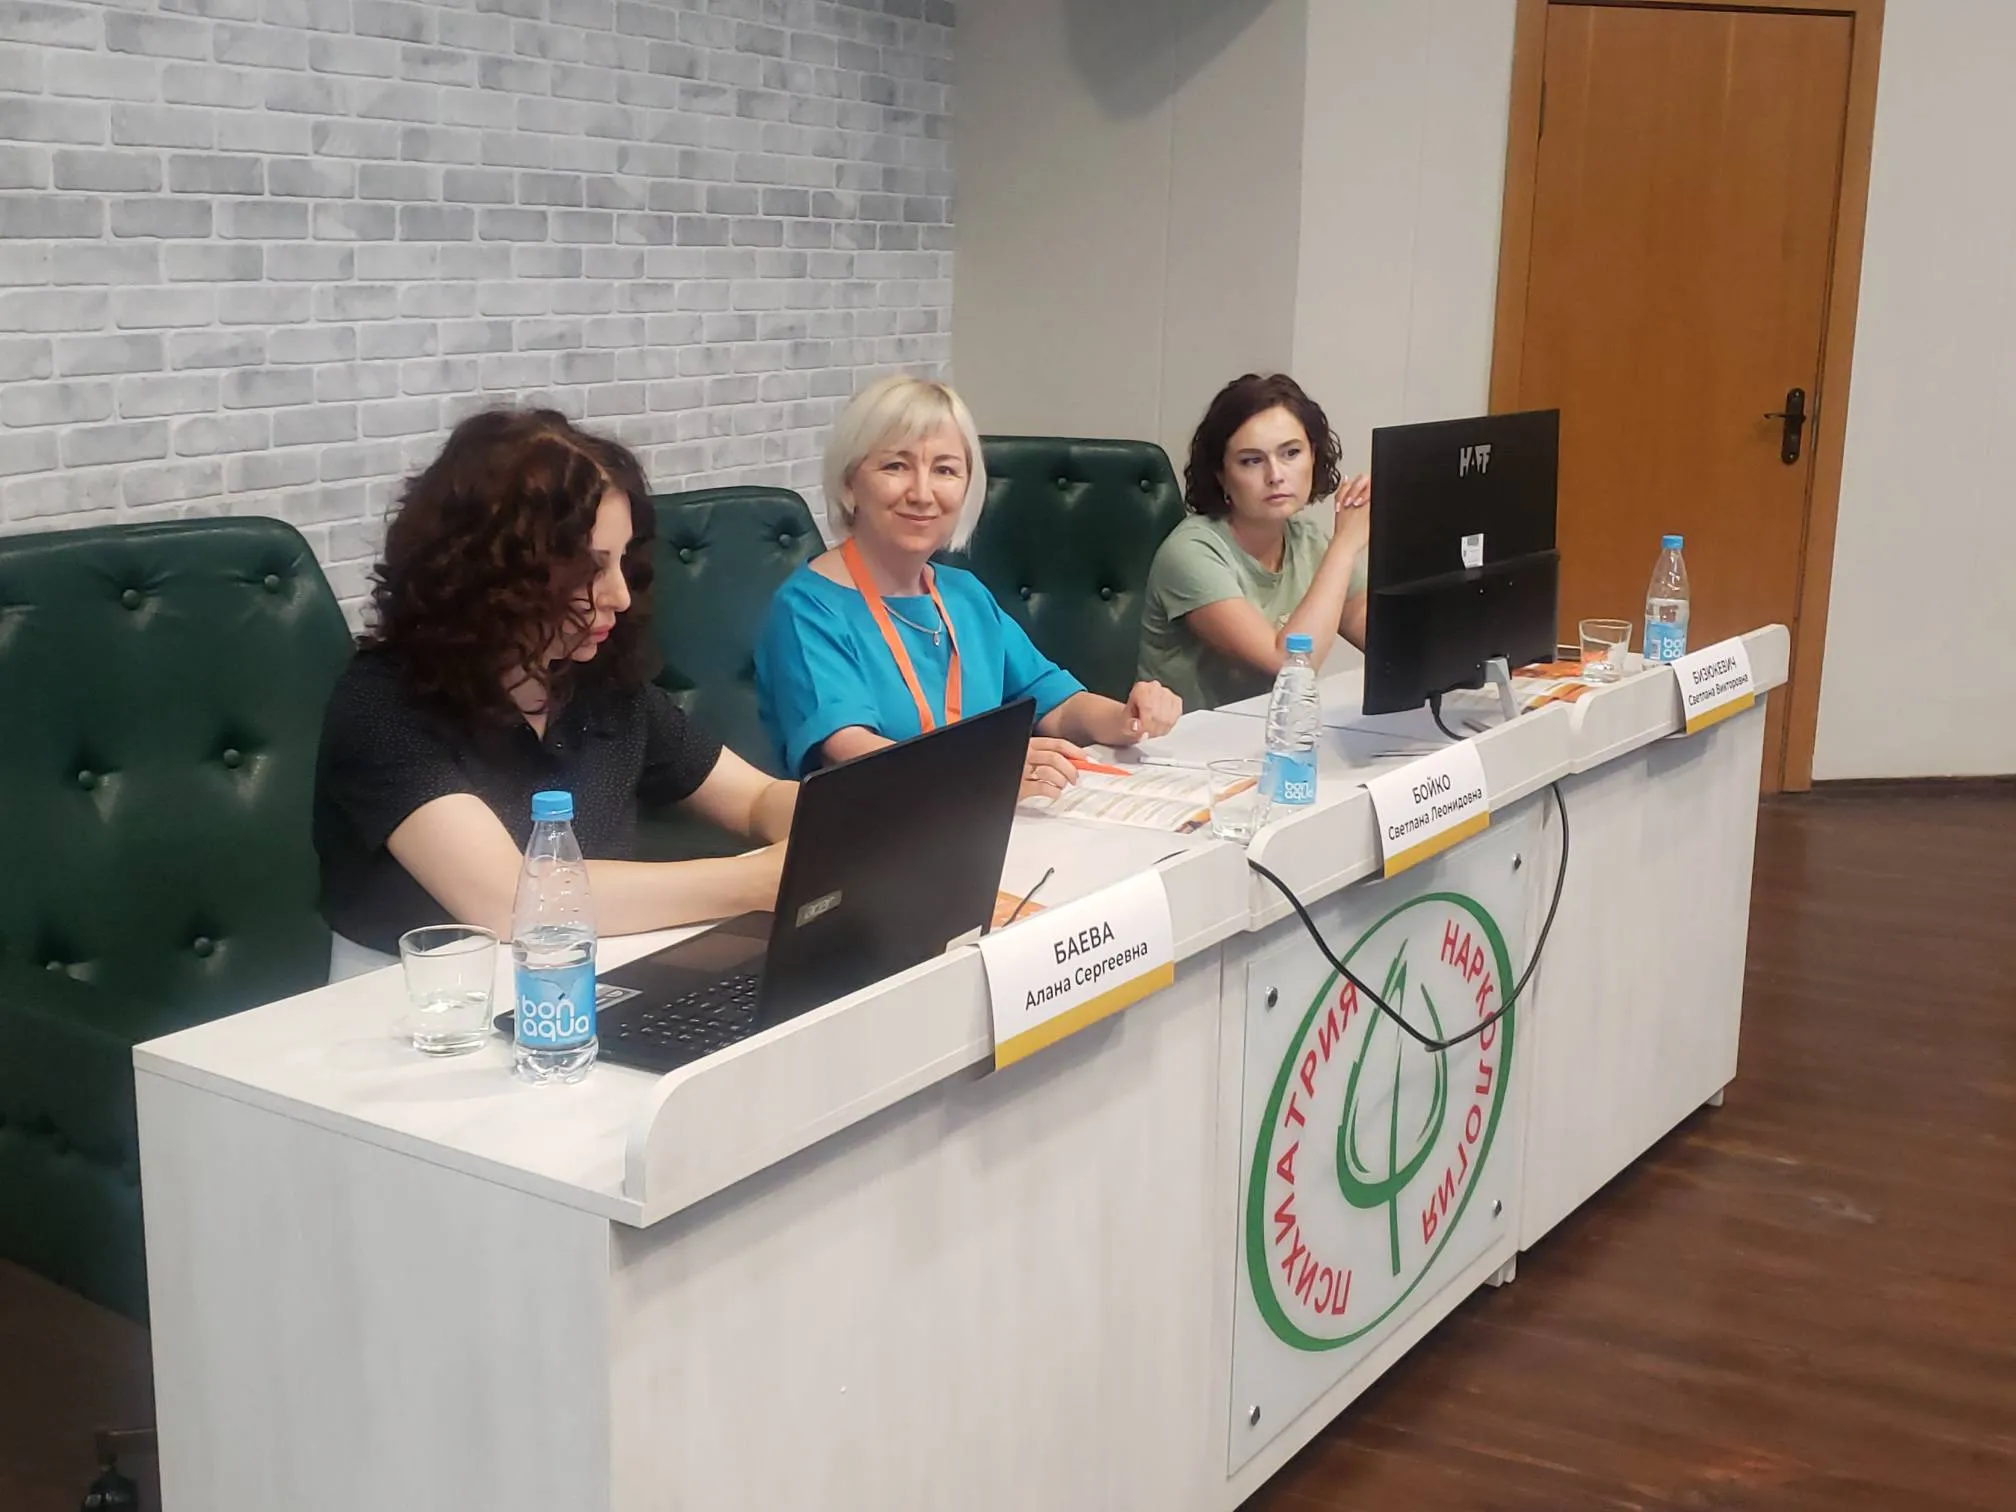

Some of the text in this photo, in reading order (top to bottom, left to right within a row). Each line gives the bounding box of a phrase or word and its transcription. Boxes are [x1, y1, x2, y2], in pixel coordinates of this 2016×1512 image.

[1692, 655, 1737, 685] БИЗЮКЕВИЧ
[1688, 673, 1749, 706] Светлана Викторовна
[1412, 774, 1451, 804] БОЙКО
[1388, 788, 1482, 841] Светлана Леонидовна
[1053, 921, 1115, 965] БАЕВА
[1025, 941, 1148, 1010] Алана Сергеевна
[522, 994, 575, 1018] bon
[522, 1015, 589, 1042] aqua
[1422, 919, 1497, 1245] НАРКОЛОГИЯ
[1274, 980, 1359, 1316] ПСИХИАТРИЯ
